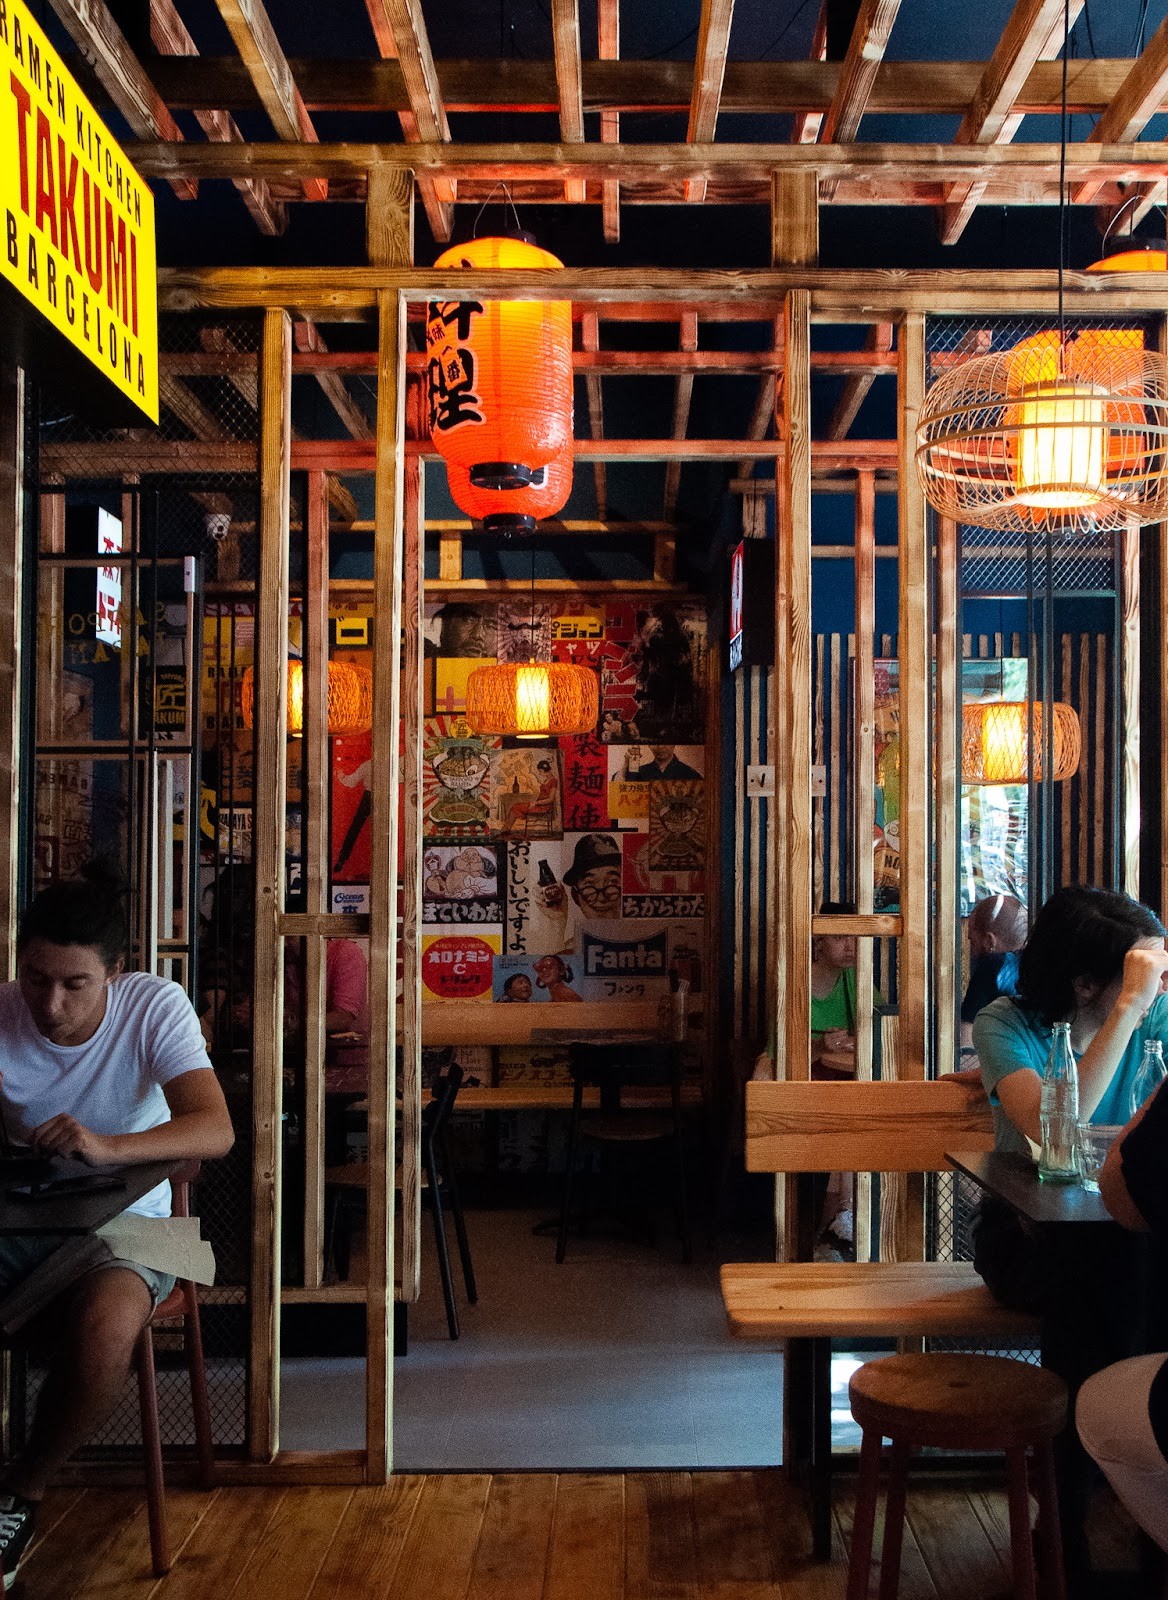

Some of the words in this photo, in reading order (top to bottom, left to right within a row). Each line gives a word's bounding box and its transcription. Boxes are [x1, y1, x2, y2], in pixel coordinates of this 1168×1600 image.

[0, 1, 66, 126] RAMEN
[76, 104, 142, 228] KITCHEN
[10, 69, 139, 339] TAKUMI
[6, 208, 146, 398] BARCELONA
[429, 950, 490, 963] オロナミン
[453, 963, 467, 974] C
[586, 944, 662, 974] Fanta
[604, 981, 646, 997] ファンタ
